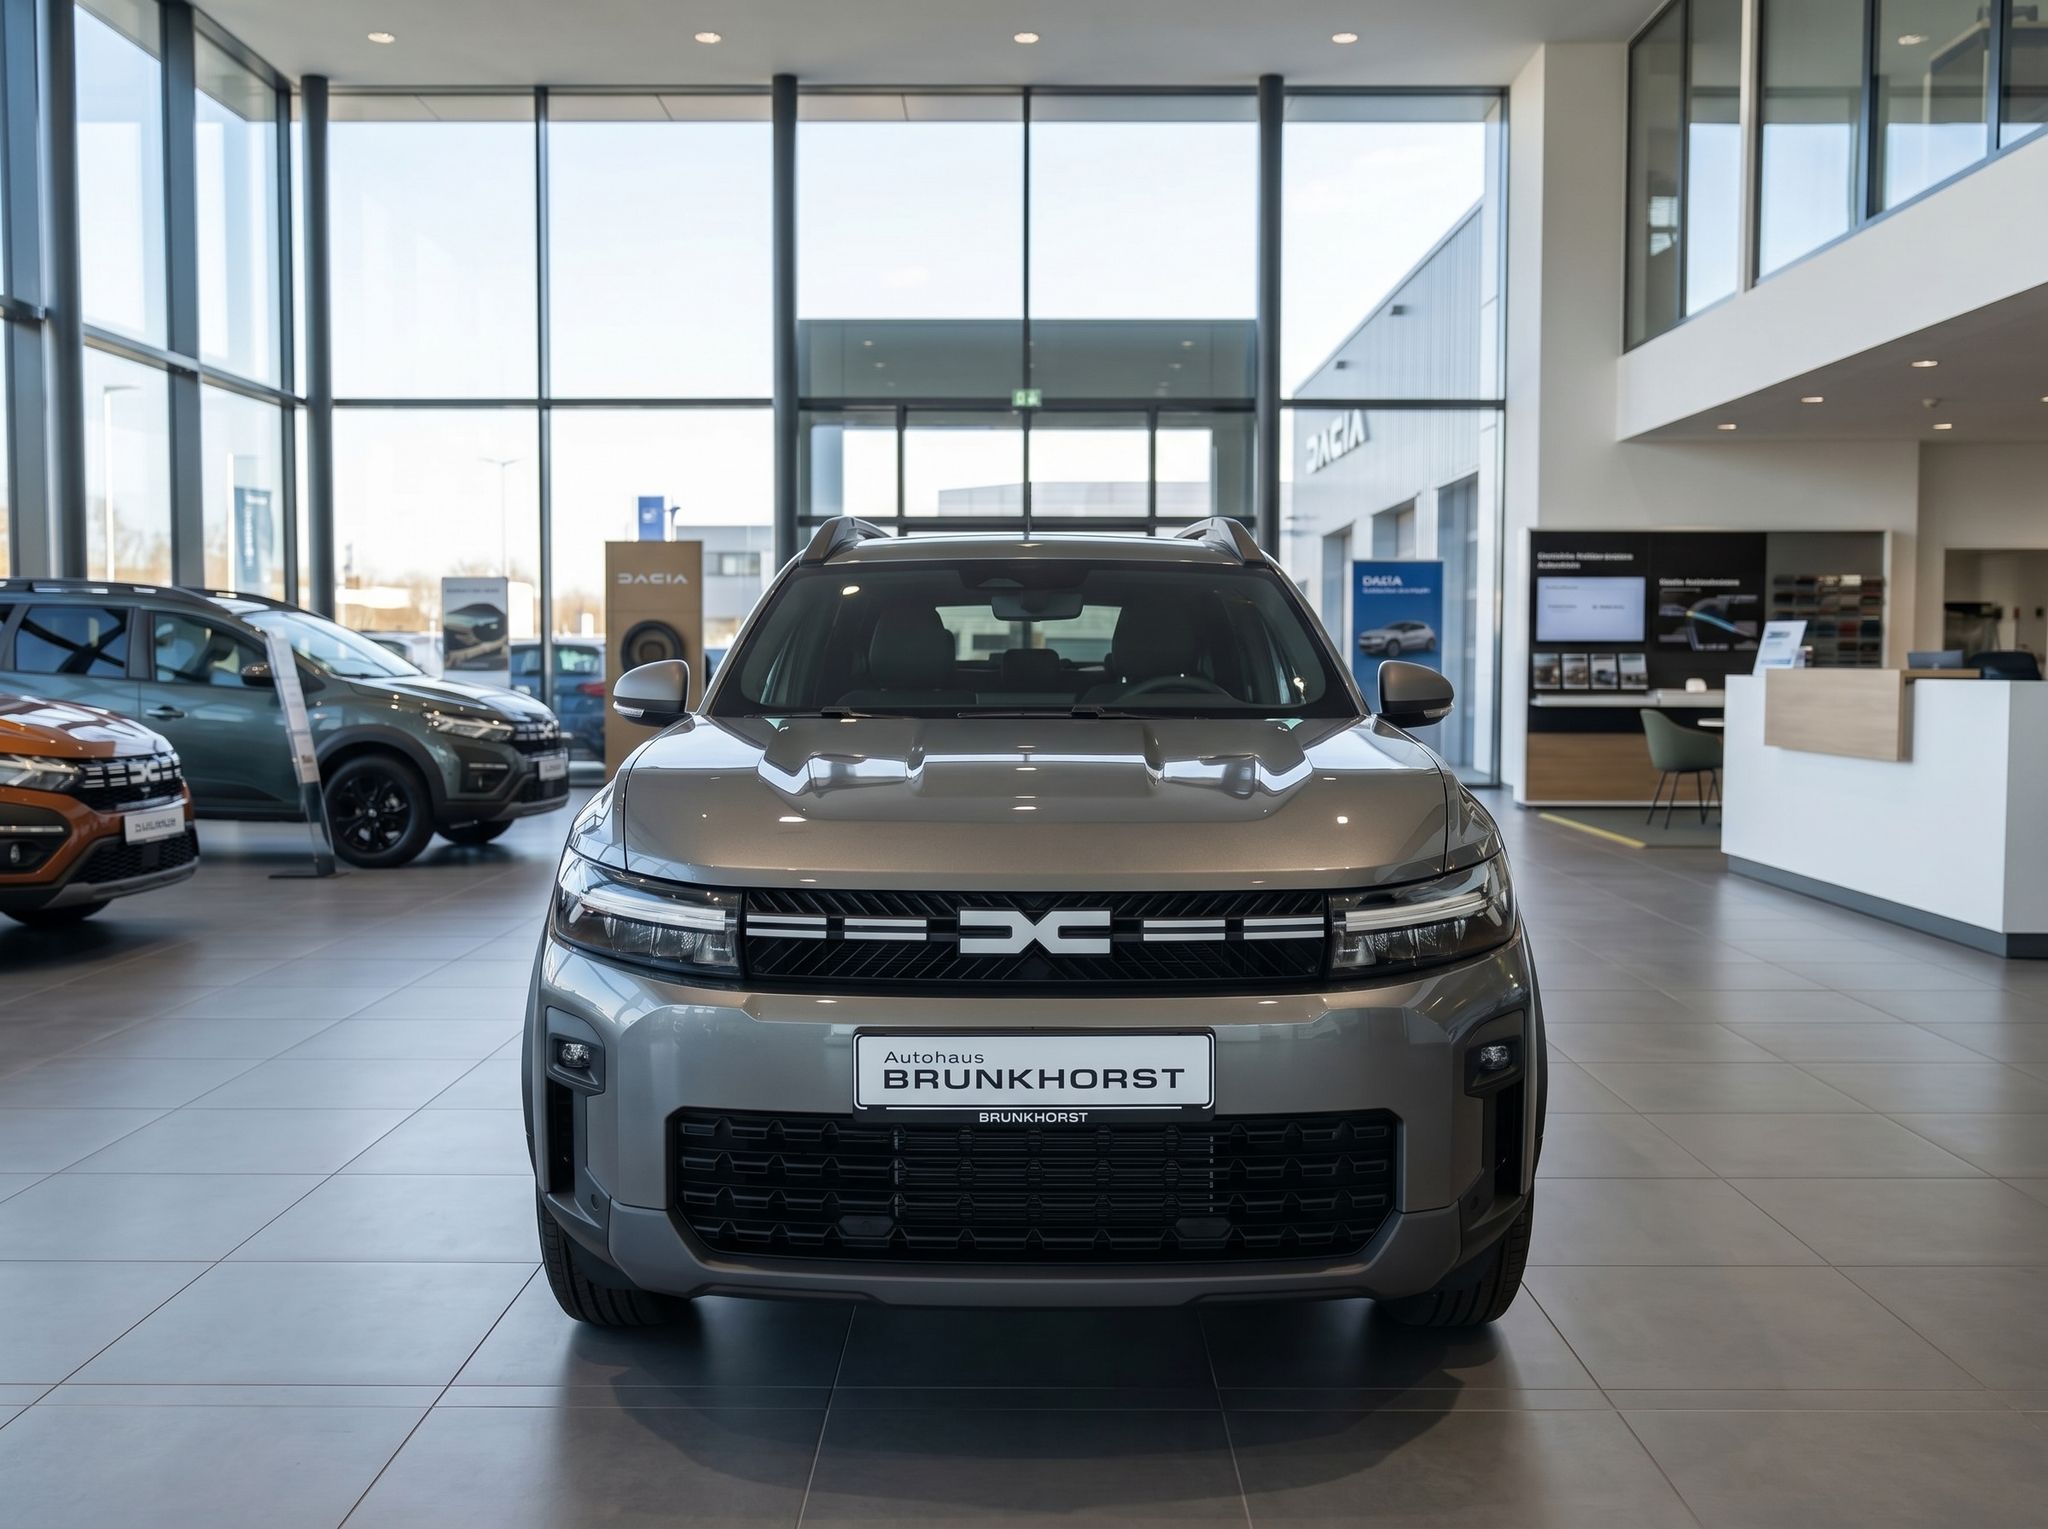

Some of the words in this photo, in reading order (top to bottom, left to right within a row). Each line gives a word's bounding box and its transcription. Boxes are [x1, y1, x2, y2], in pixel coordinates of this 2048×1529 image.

[1306, 409, 1365, 473] DACIA
[617, 572, 689, 585] DACIA
[884, 1051, 985, 1064] Autohaus
[883, 1068, 1185, 1090] BRUNKHORST
[978, 1112, 1089, 1123] BRUNKHORST
